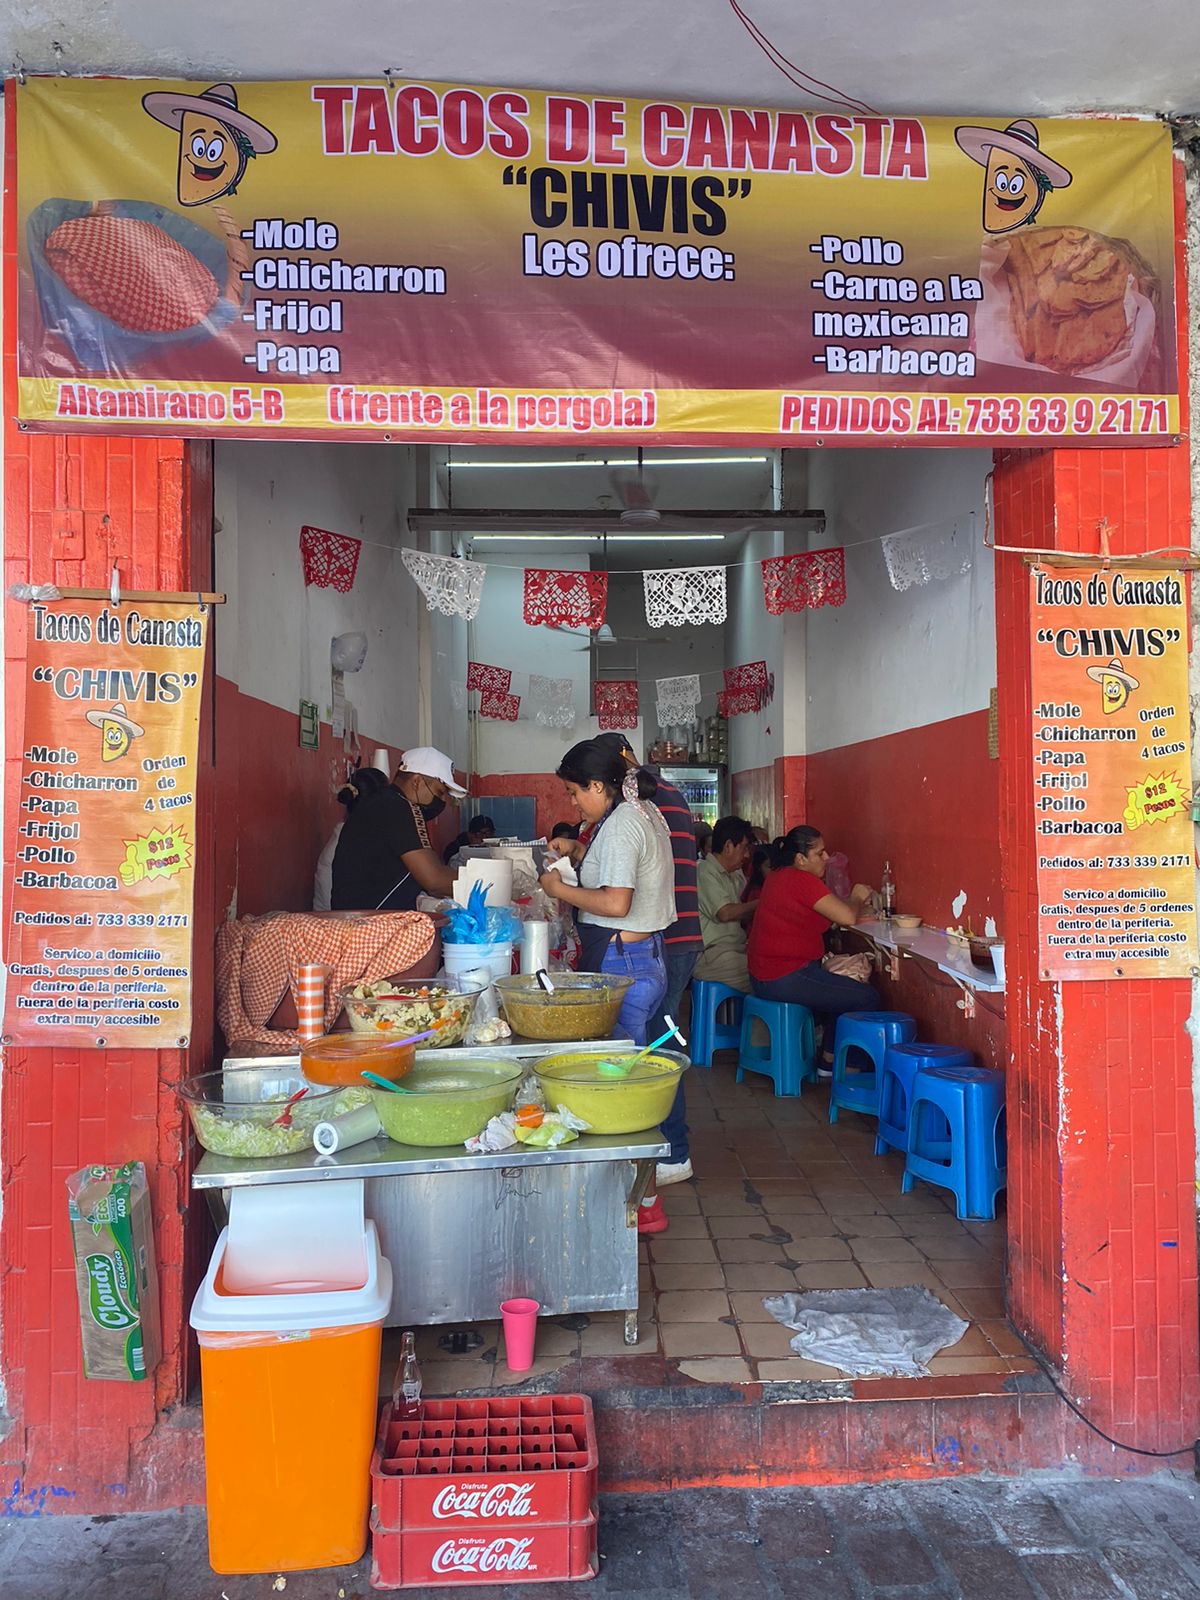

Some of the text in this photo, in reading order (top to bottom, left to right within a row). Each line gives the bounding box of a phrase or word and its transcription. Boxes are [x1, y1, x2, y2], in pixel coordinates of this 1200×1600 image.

[312, 85, 930, 182] TACOS DE CANASTA
[503, 165, 751, 236] “CHIVIS”
[241, 219, 338, 251] -Mole
[523, 234, 735, 281] Les ofrece:
[810, 235, 903, 266] -Pollo
[241, 258, 446, 296] -Chicharron
[811, 270, 984, 303] -Carne a la
[242, 299, 343, 335] -Frijol
[813, 309, 969, 339] mexicana
[243, 342, 342, 376] -Papa
[812, 346, 977, 379] -Barbacoa
[57, 382, 285, 424] Altamirano 5-B
[327, 386, 657, 433] (frente a la pergola)
[780, 394, 911, 434] PEDIDOS
[915, 397, 960, 434] AL:
[965, 396, 1022, 435] 733
[1027, 397, 1068, 435] 33
[1073, 398, 1095, 435] 9
[1035, 573, 1183, 606] Tacos de Canasta
[34, 606, 203, 647] Tacos de Canasta
[1037, 628, 1180, 657] “CHIVIS”
[33, 668, 198, 703] “CHIVIS”
[1035, 703, 1081, 718] -Mole
[1139, 706, 1175, 722] Orden
[1036, 726, 1137, 741] -Chicharron
[1152, 726, 1166, 738] de
[25, 747, 78, 764] -Mole
[1036, 750, 1085, 767] -Papa
[1142, 741, 1186, 759] 4 tacos
[143, 754, 187, 772] Orden
[24, 772, 138, 791] -Chicharron
[157, 776, 176, 790] de
[1036, 773, 1088, 791] -Frijol
[22, 796, 79, 816] -Papa
[145, 793, 193, 812] 4 tacos
[1037, 797, 1086, 812] -Pollo
[1144, 798, 1177, 815] Pesos
[20, 821, 80, 842] -Frijol
[1037, 820, 1123, 834] -Barbacoa
[148, 836, 175, 854] $12
[18, 846, 76, 864] -Pollo
[146, 853, 181, 871] Pesos
[1040, 855, 1190, 868] Pedidos al: 733 339 2171
[16, 872, 118, 890] -Barbacoa
[1063, 888, 1167, 899] Servico a domicilio
[1041, 902, 1194, 915] Gratis, despues de 5 ordenes
[14, 911, 188, 927] Pedidos al: 733 339 2171
[1057, 917, 1174, 930] dentro de la periferia.
[1048, 933, 1187, 946] Fuera de la periferia costo
[44, 948, 162, 960] Servico a domicilio
[1065, 948, 1170, 961] extra muy accesible
[10, 963, 188, 978] Gratis, despues de 5 ordenes
[32, 980, 167, 995] dentro de la periferia.
[17, 996, 181, 1011] Fuera de la periferia costo
[37, 1014, 161, 1027] extra muy accesible
[117, 1198, 126, 1217] 400
[90, 1258, 130, 1328] Cloudy
[432, 1482, 536, 1519] Coca-Cola
[431, 1537, 535, 1573] Coca-Cola
